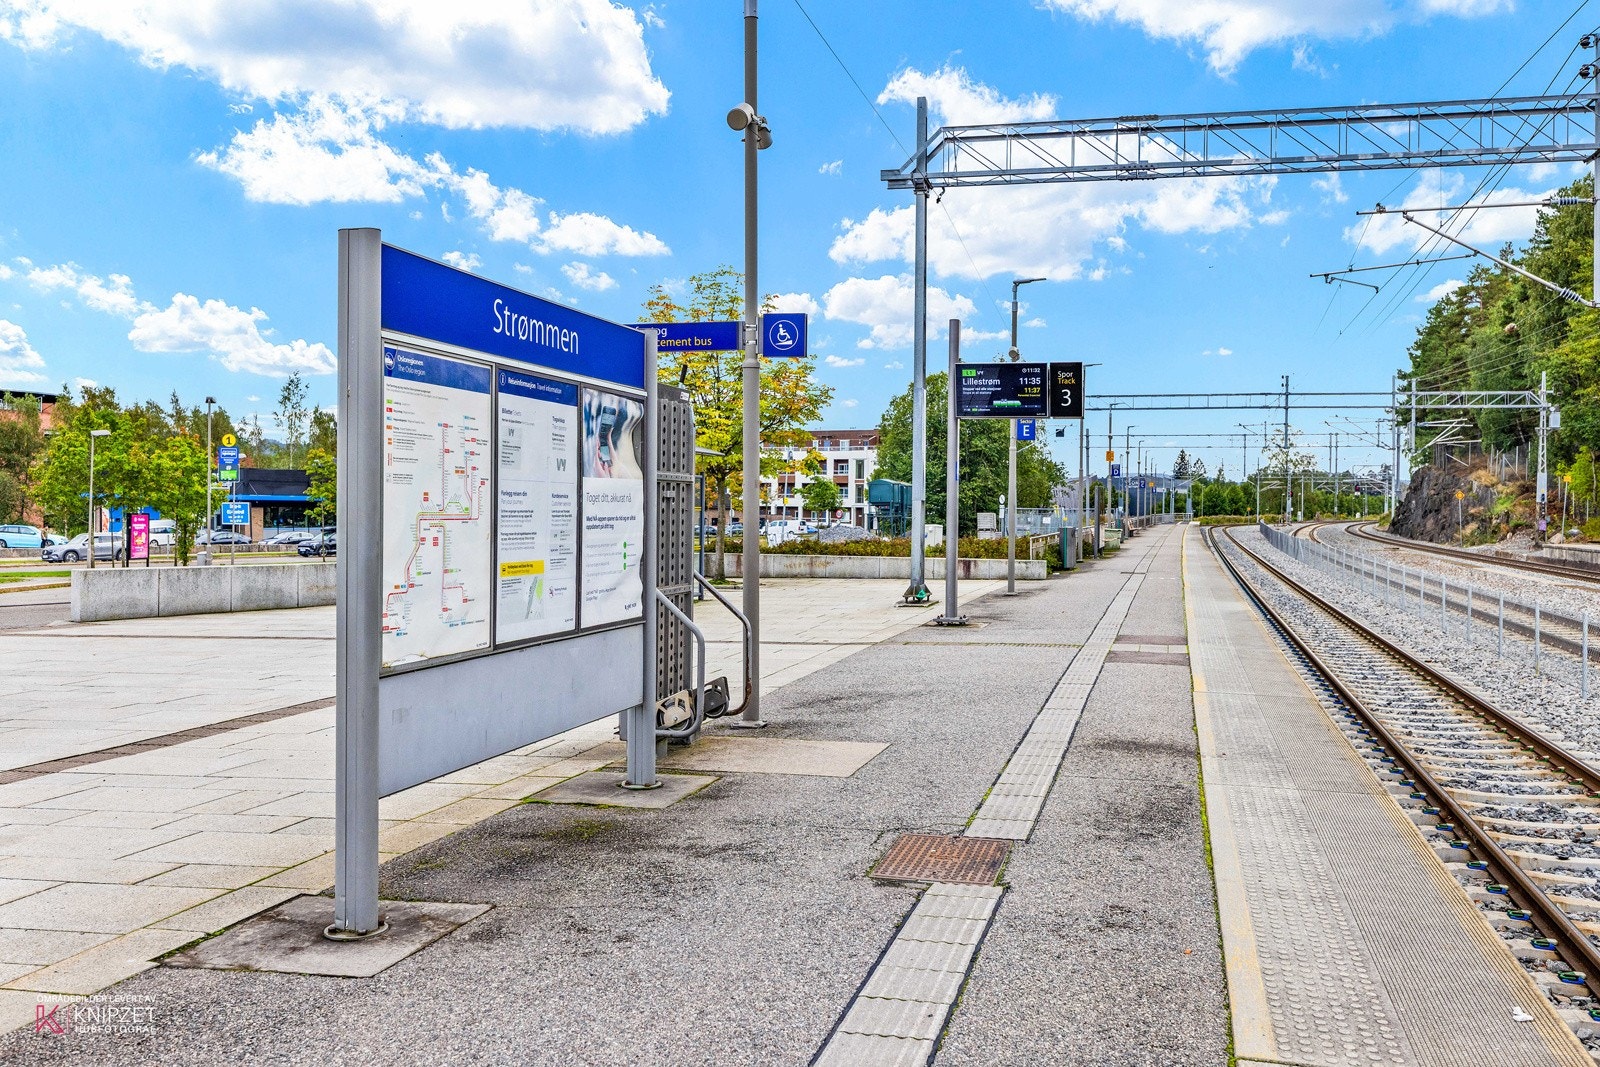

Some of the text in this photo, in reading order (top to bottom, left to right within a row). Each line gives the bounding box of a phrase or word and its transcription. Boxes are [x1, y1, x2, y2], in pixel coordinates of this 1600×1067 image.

[493, 298, 579, 355] Strømmen
[657, 336, 712, 347] cement bus
[1057, 371, 1073, 379] Spor
[962, 377, 1041, 385] Lillestrøm 11:35
[1061, 389, 1071, 406] 3
[1023, 425, 1029, 436] E
[225, 436, 231, 445] 1
